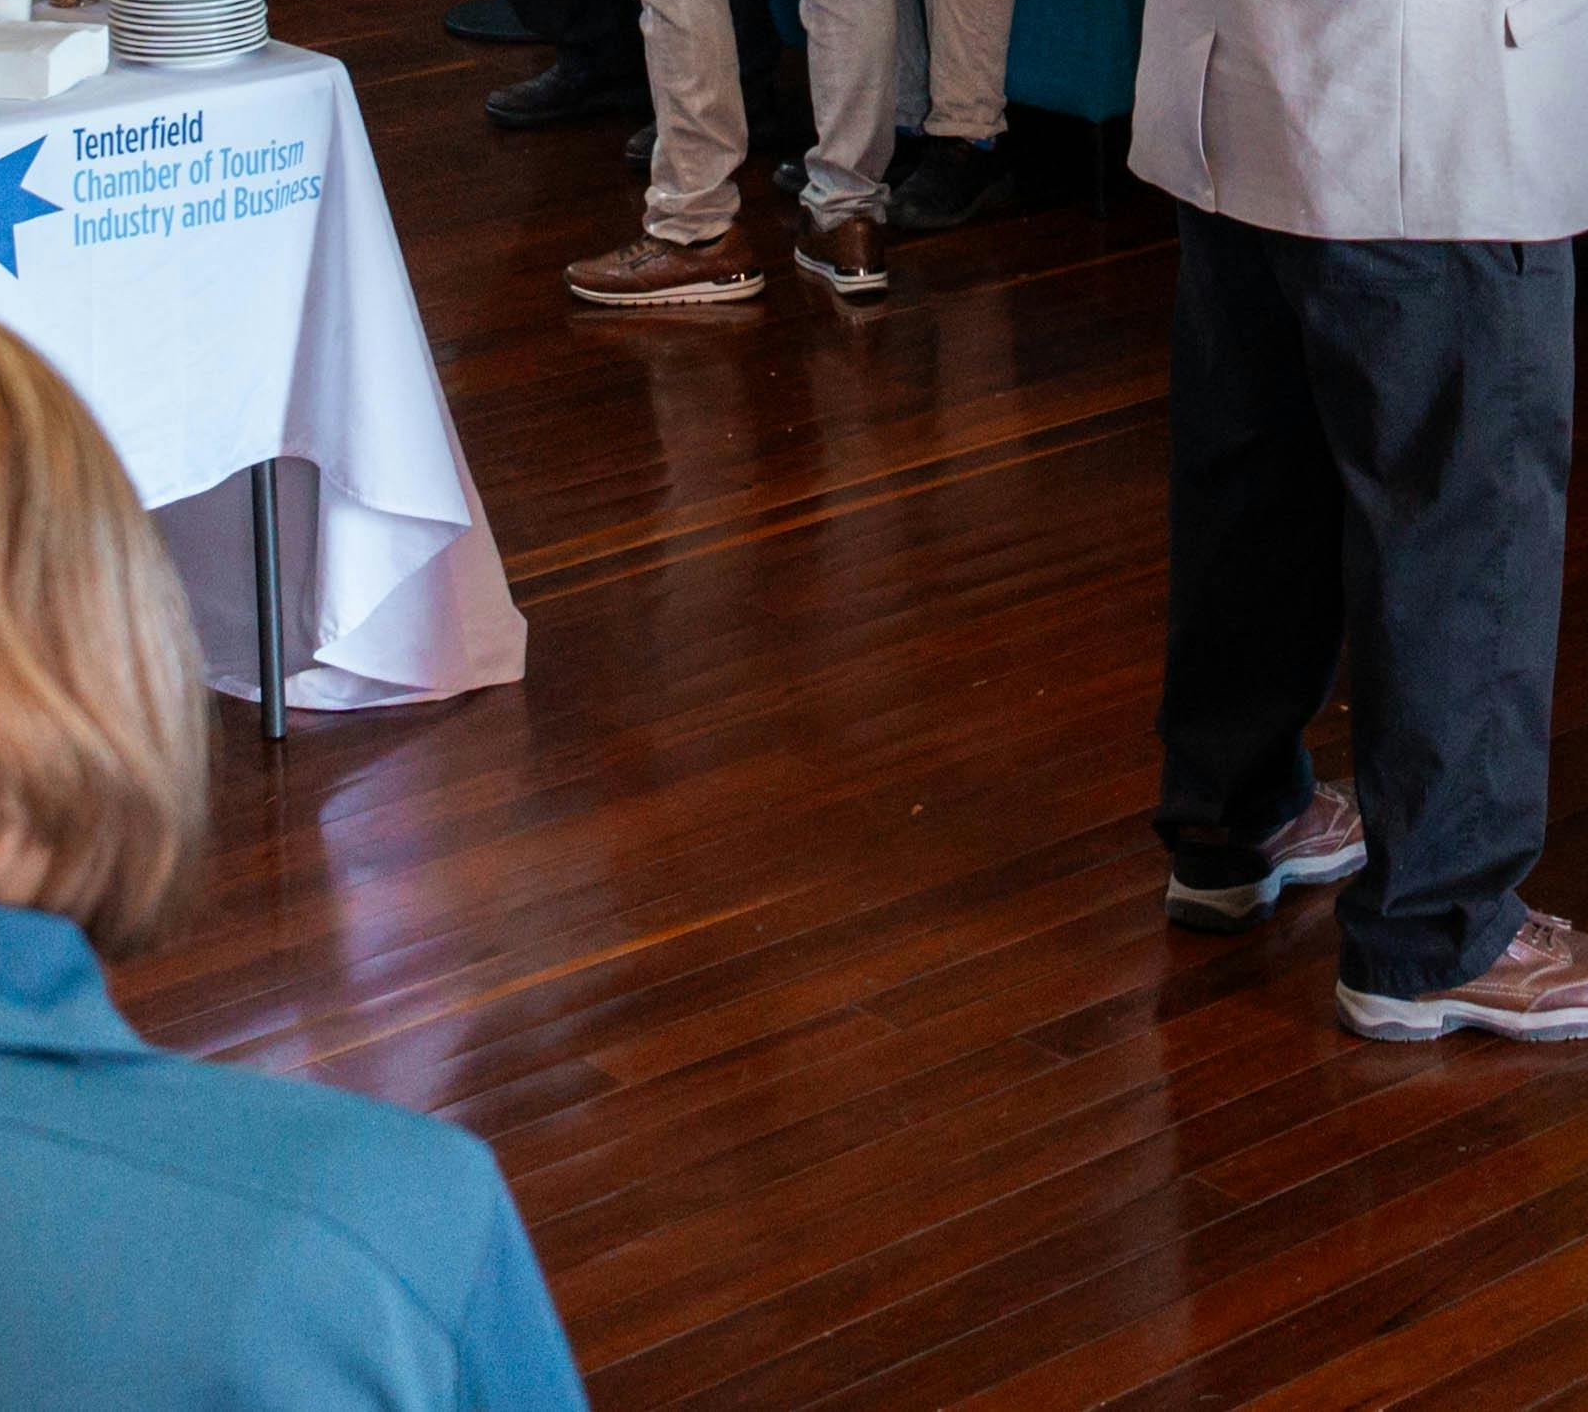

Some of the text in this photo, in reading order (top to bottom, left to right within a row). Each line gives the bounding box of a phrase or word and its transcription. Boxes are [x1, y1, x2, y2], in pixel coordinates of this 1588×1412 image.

[73, 110, 203, 161] Tenterfield
[73, 139, 305, 203] Chamber of Tourism
[74, 175, 322, 247] Industry and Business
